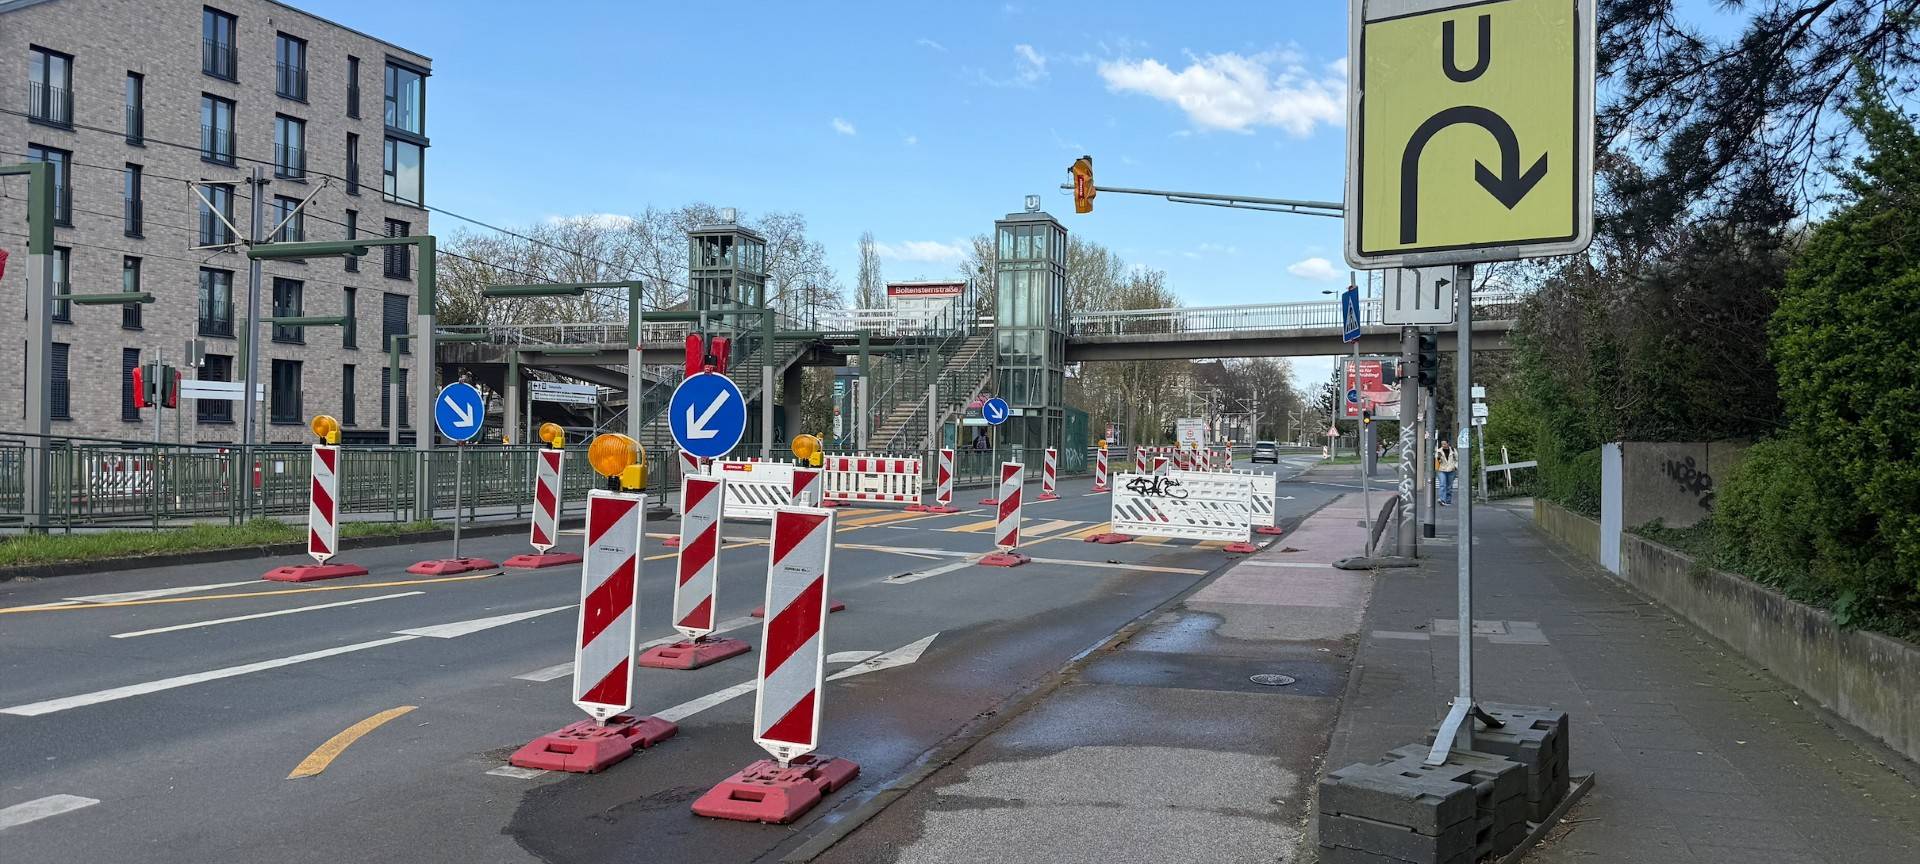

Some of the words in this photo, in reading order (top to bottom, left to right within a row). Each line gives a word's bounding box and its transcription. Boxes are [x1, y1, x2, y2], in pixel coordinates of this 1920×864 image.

[1442, 14, 1491, 83] U
[1027, 197, 1037, 208] U
[895, 285, 959, 294] Boltensternstraße
